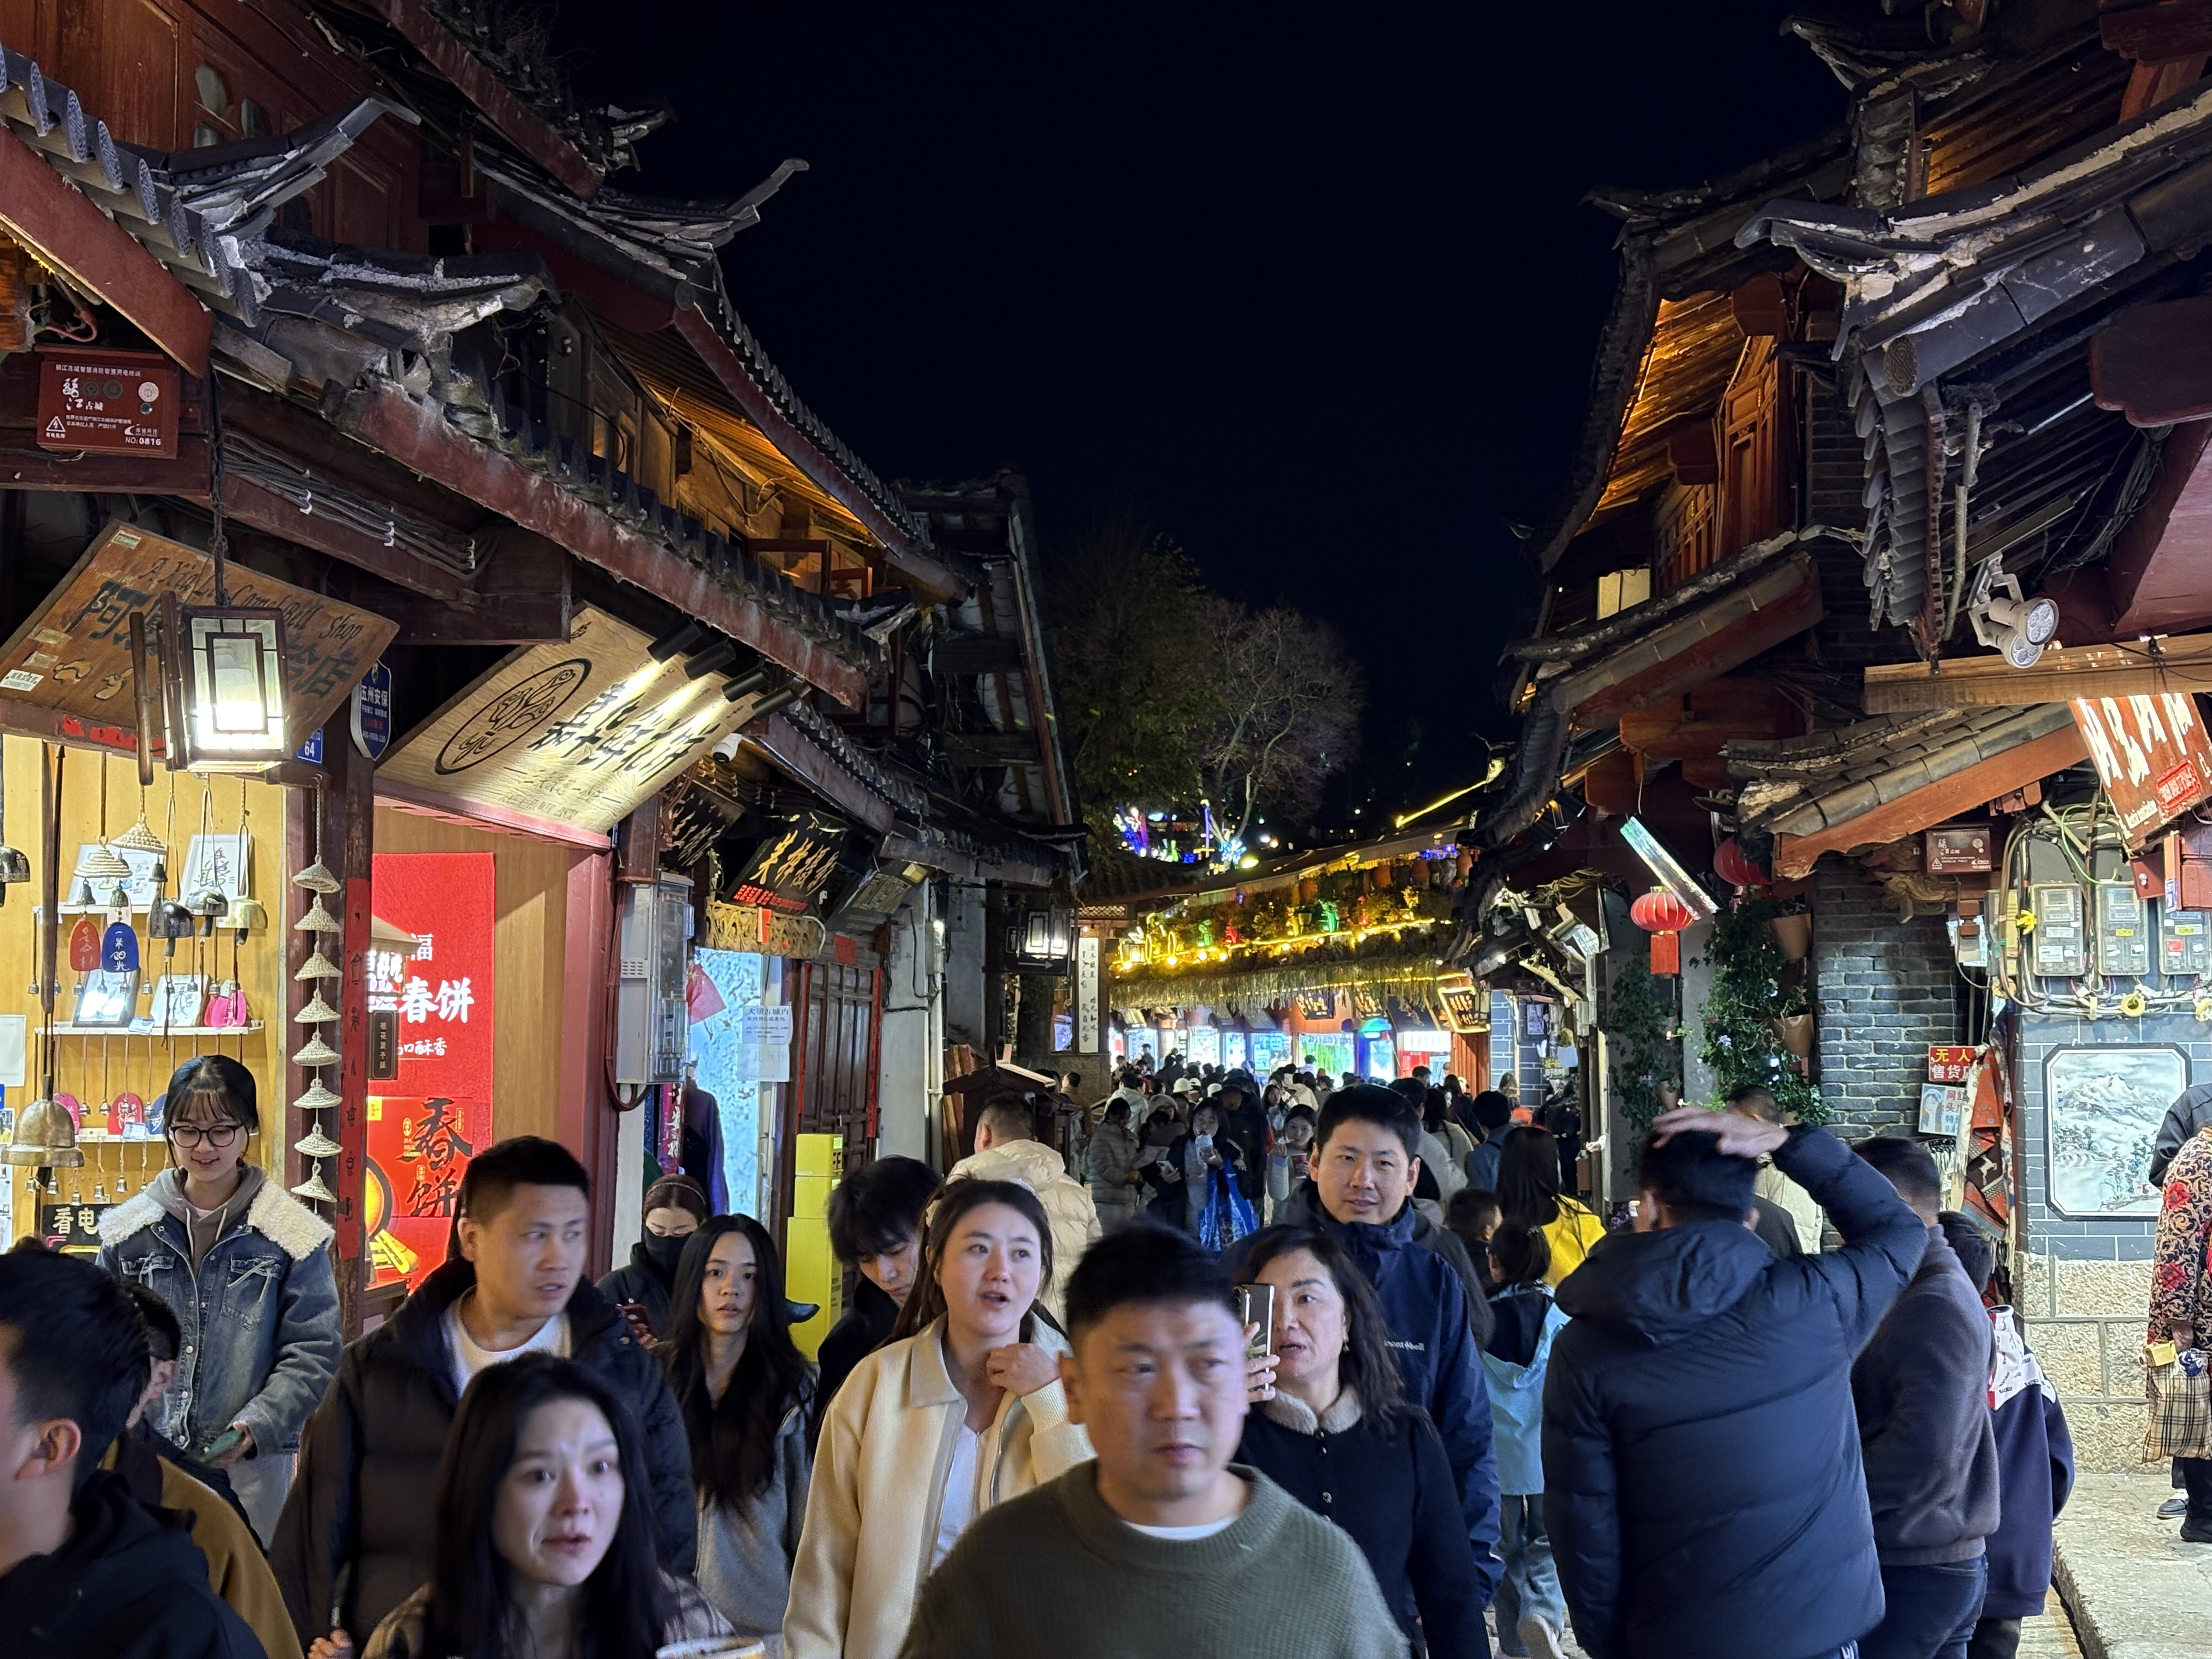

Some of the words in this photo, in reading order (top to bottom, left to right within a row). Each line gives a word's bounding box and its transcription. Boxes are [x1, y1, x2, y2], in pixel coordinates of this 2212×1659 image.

[283, 602, 325, 632] Bell
[319, 613, 364, 649] Shop
[304, 740, 315, 758] 64
[109, 930, 131, 972] 一米阳光
[398, 1037, 447, 1056] 口酥香
[1936, 1048, 1971, 1062] 无人
[53, 1207, 99, 1235] 看电
